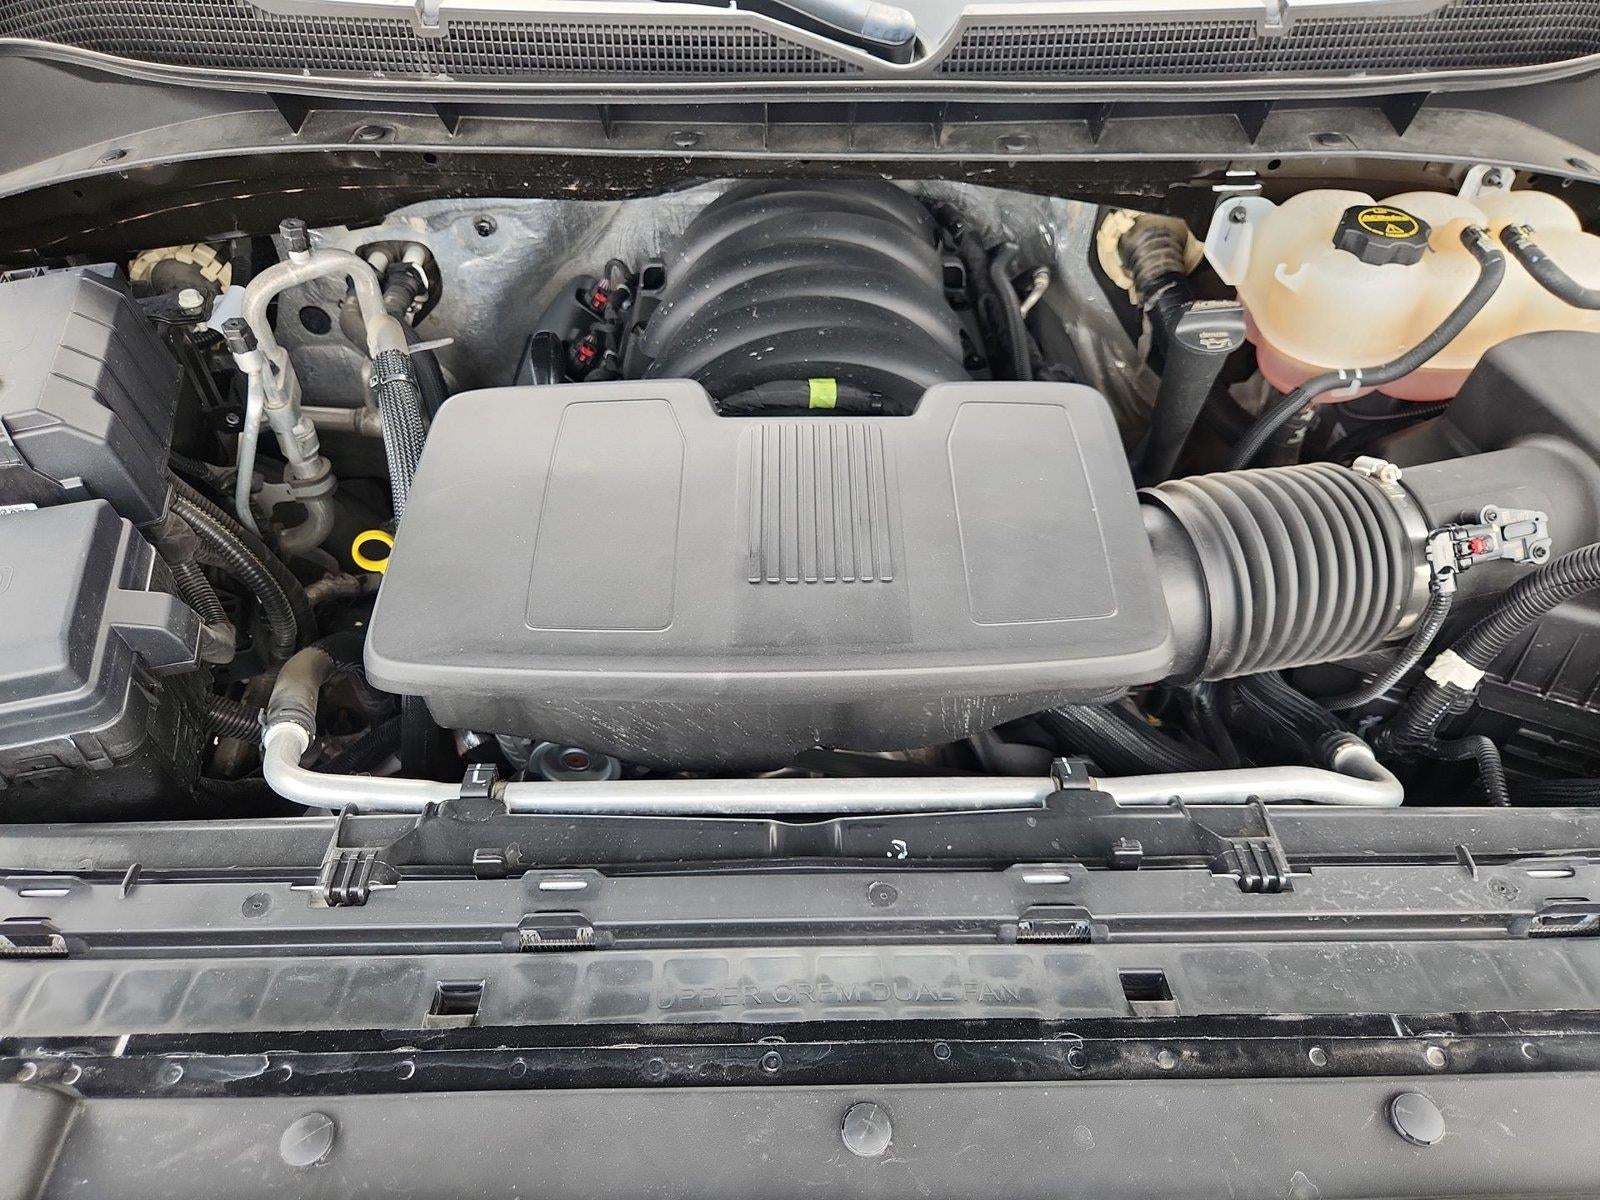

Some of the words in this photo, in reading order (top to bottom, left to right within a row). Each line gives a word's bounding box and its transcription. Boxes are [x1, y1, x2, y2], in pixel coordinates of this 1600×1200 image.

[657, 985, 762, 1009] UPPER
[872, 982, 954, 1002] DUAL
[963, 982, 1021, 1002] FAN
